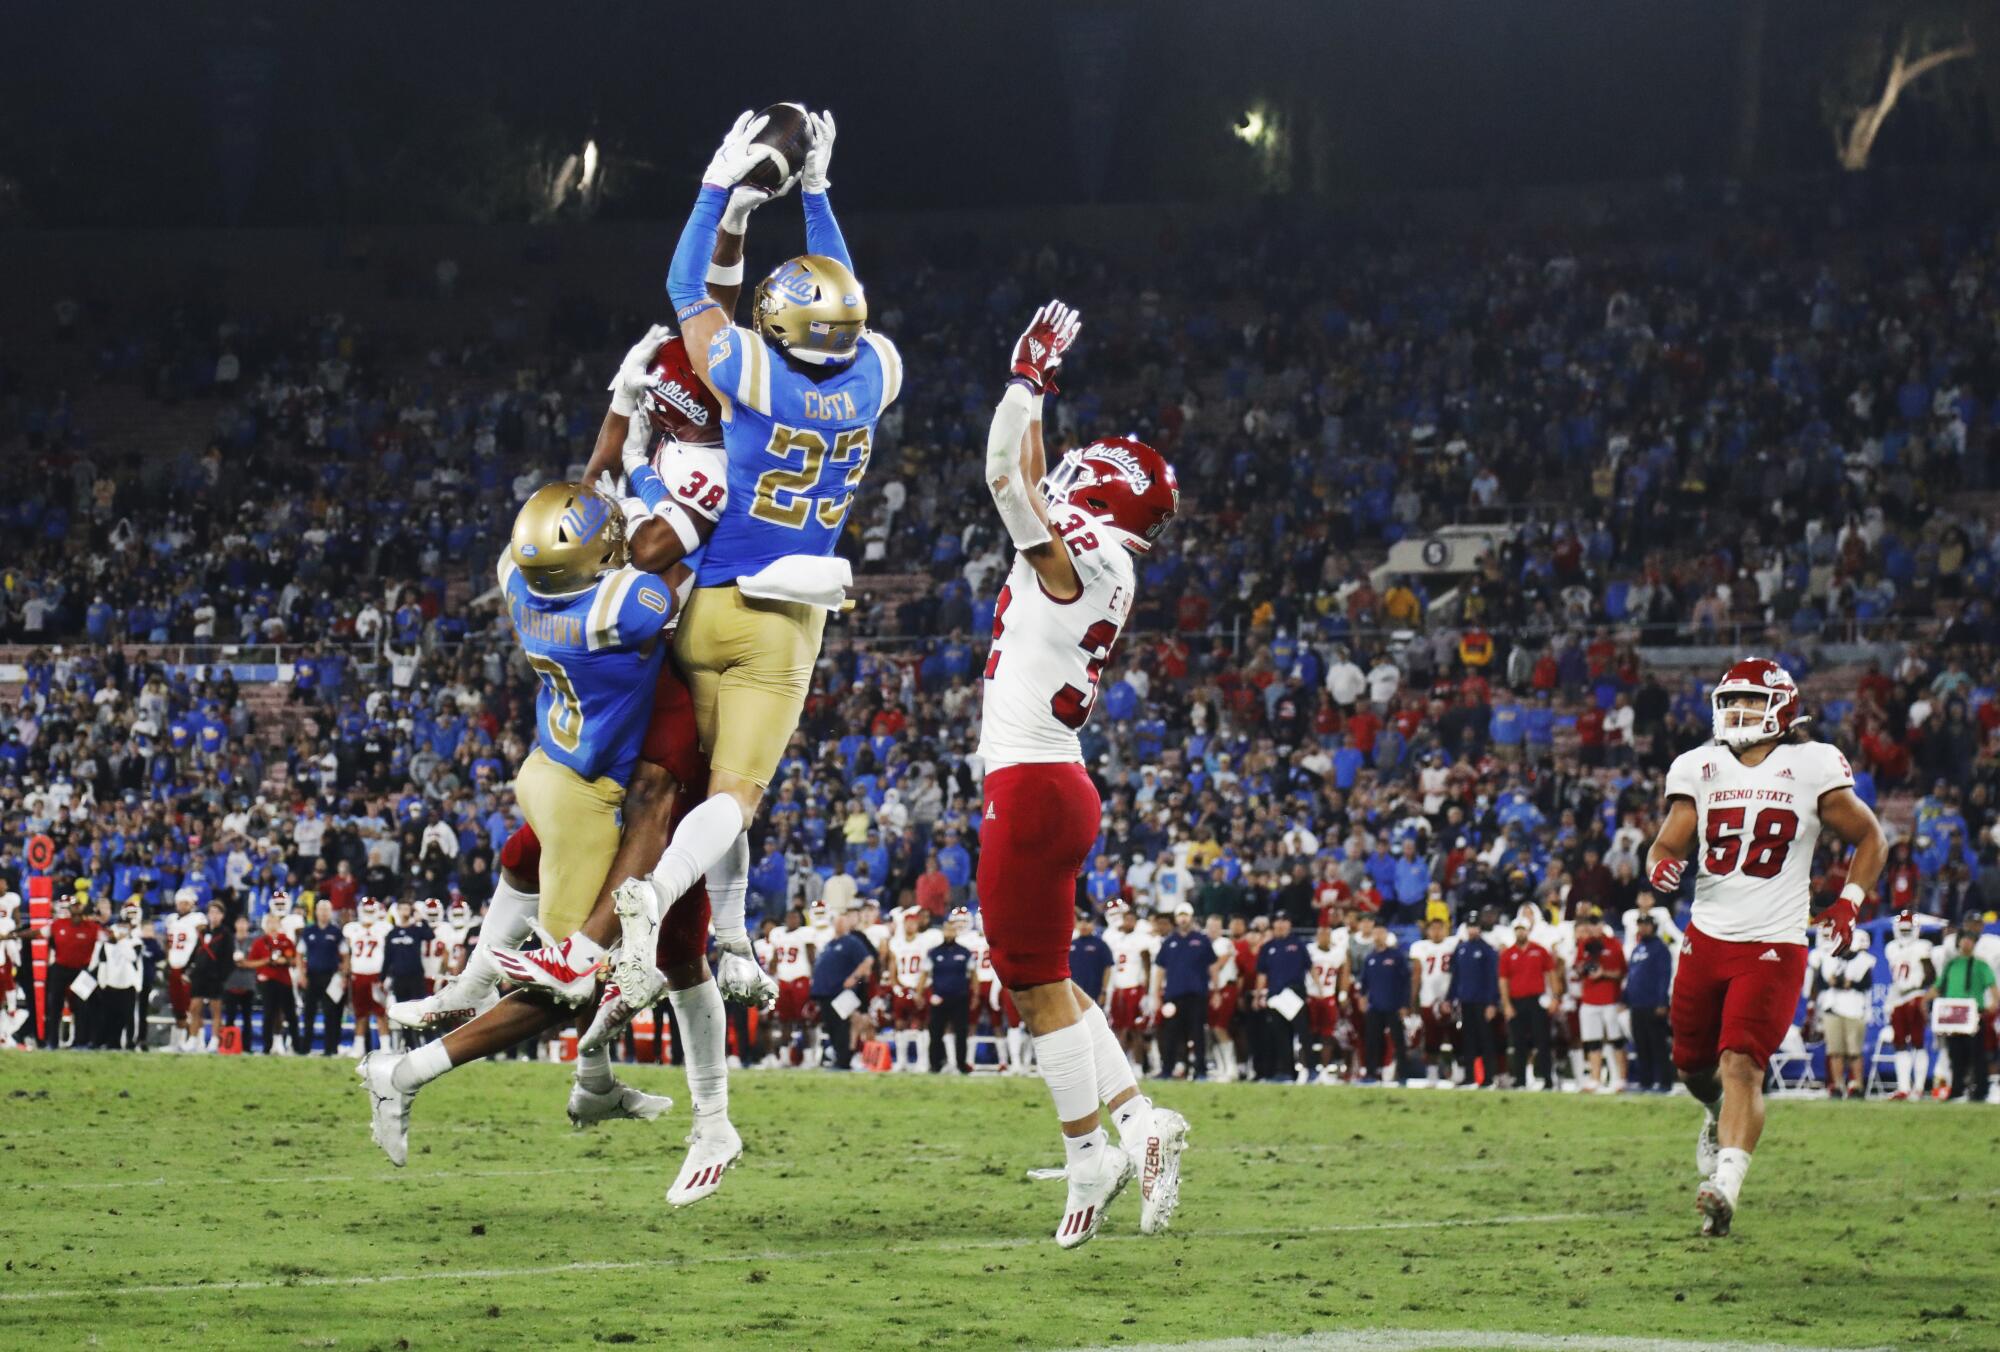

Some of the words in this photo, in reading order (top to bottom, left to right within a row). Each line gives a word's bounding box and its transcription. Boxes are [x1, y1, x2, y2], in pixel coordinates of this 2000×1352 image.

[678, 470, 726, 511] 38
[749, 422, 871, 530] 23
[1053, 513, 1099, 558] 32
[637, 587, 667, 615] 0
[1708, 789, 1753, 804] FRESNO
[1756, 789, 1794, 804] STATE
[1705, 806, 1799, 879] 58
[355, 940, 379, 958] 37
[900, 956, 921, 974] 10
[419, 1007, 477, 1024] ADIZERO
[1142, 1136, 1160, 1202] ADIZERO
